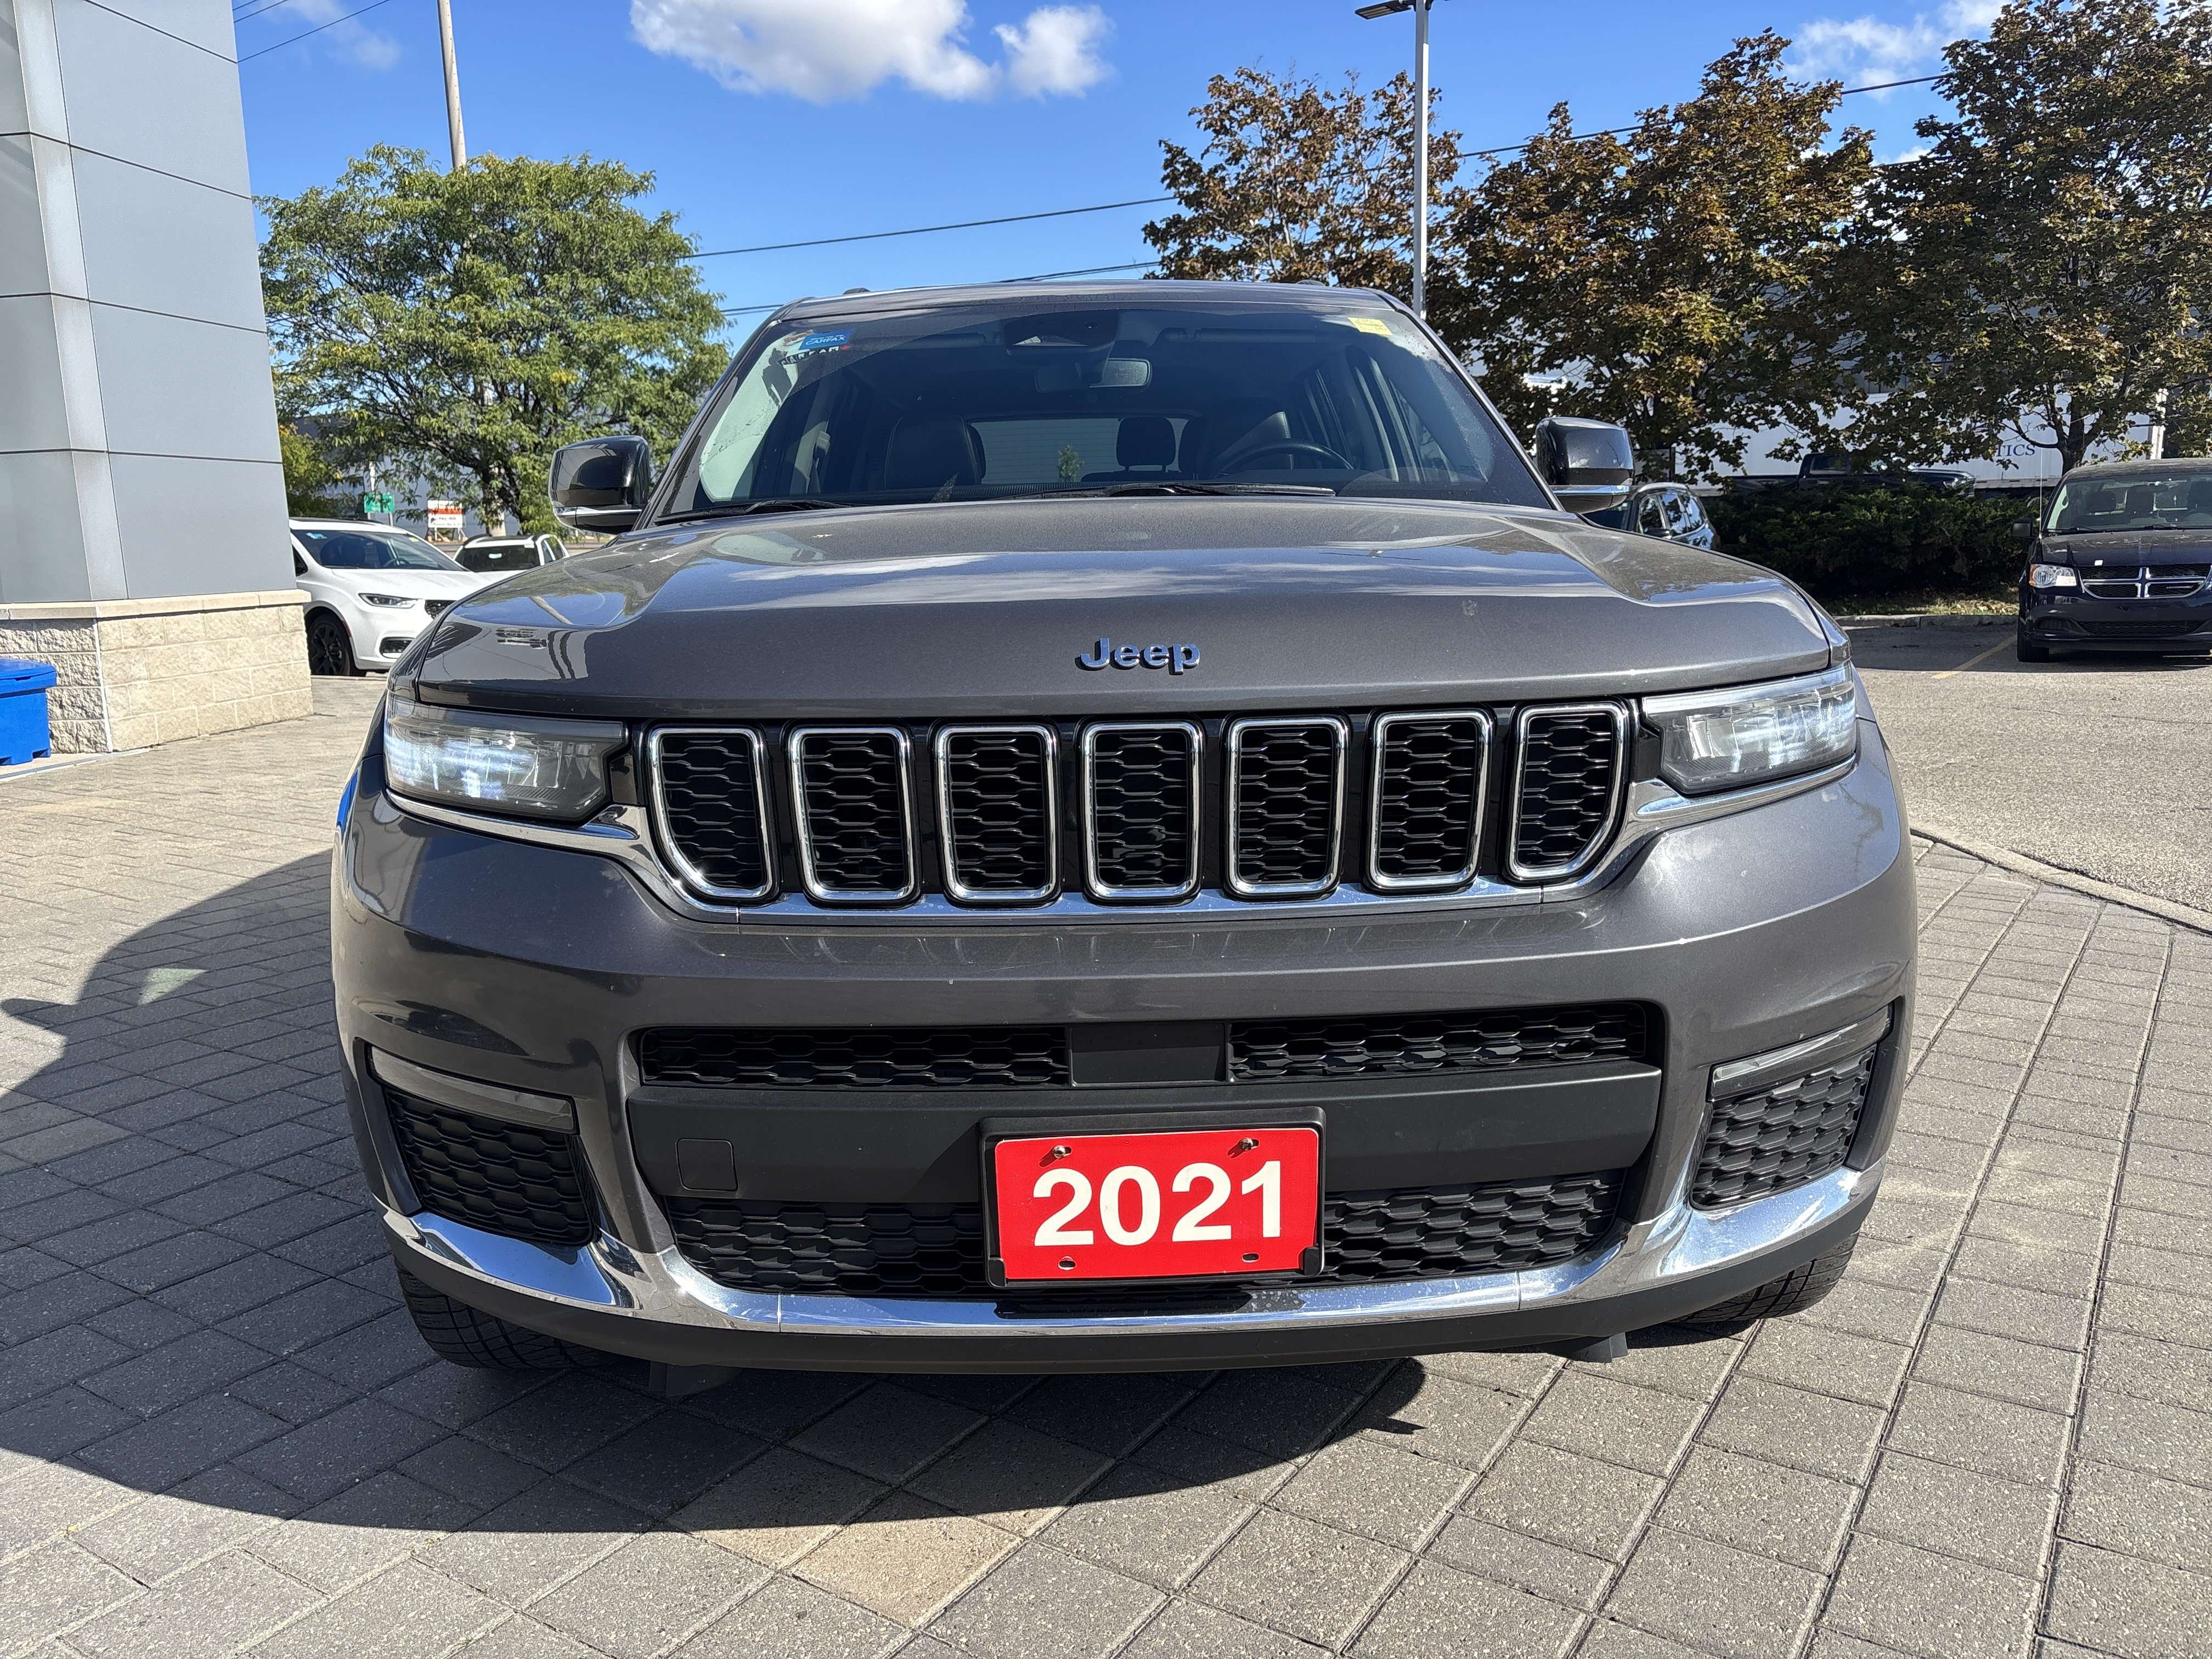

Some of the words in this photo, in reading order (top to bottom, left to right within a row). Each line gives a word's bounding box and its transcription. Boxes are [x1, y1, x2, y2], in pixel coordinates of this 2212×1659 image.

[805, 336, 845, 346] CARFAX
[1996, 443, 2036, 457] TICS
[1077, 637, 1201, 675] Jeep
[1032, 1160, 1282, 1247] 2021
